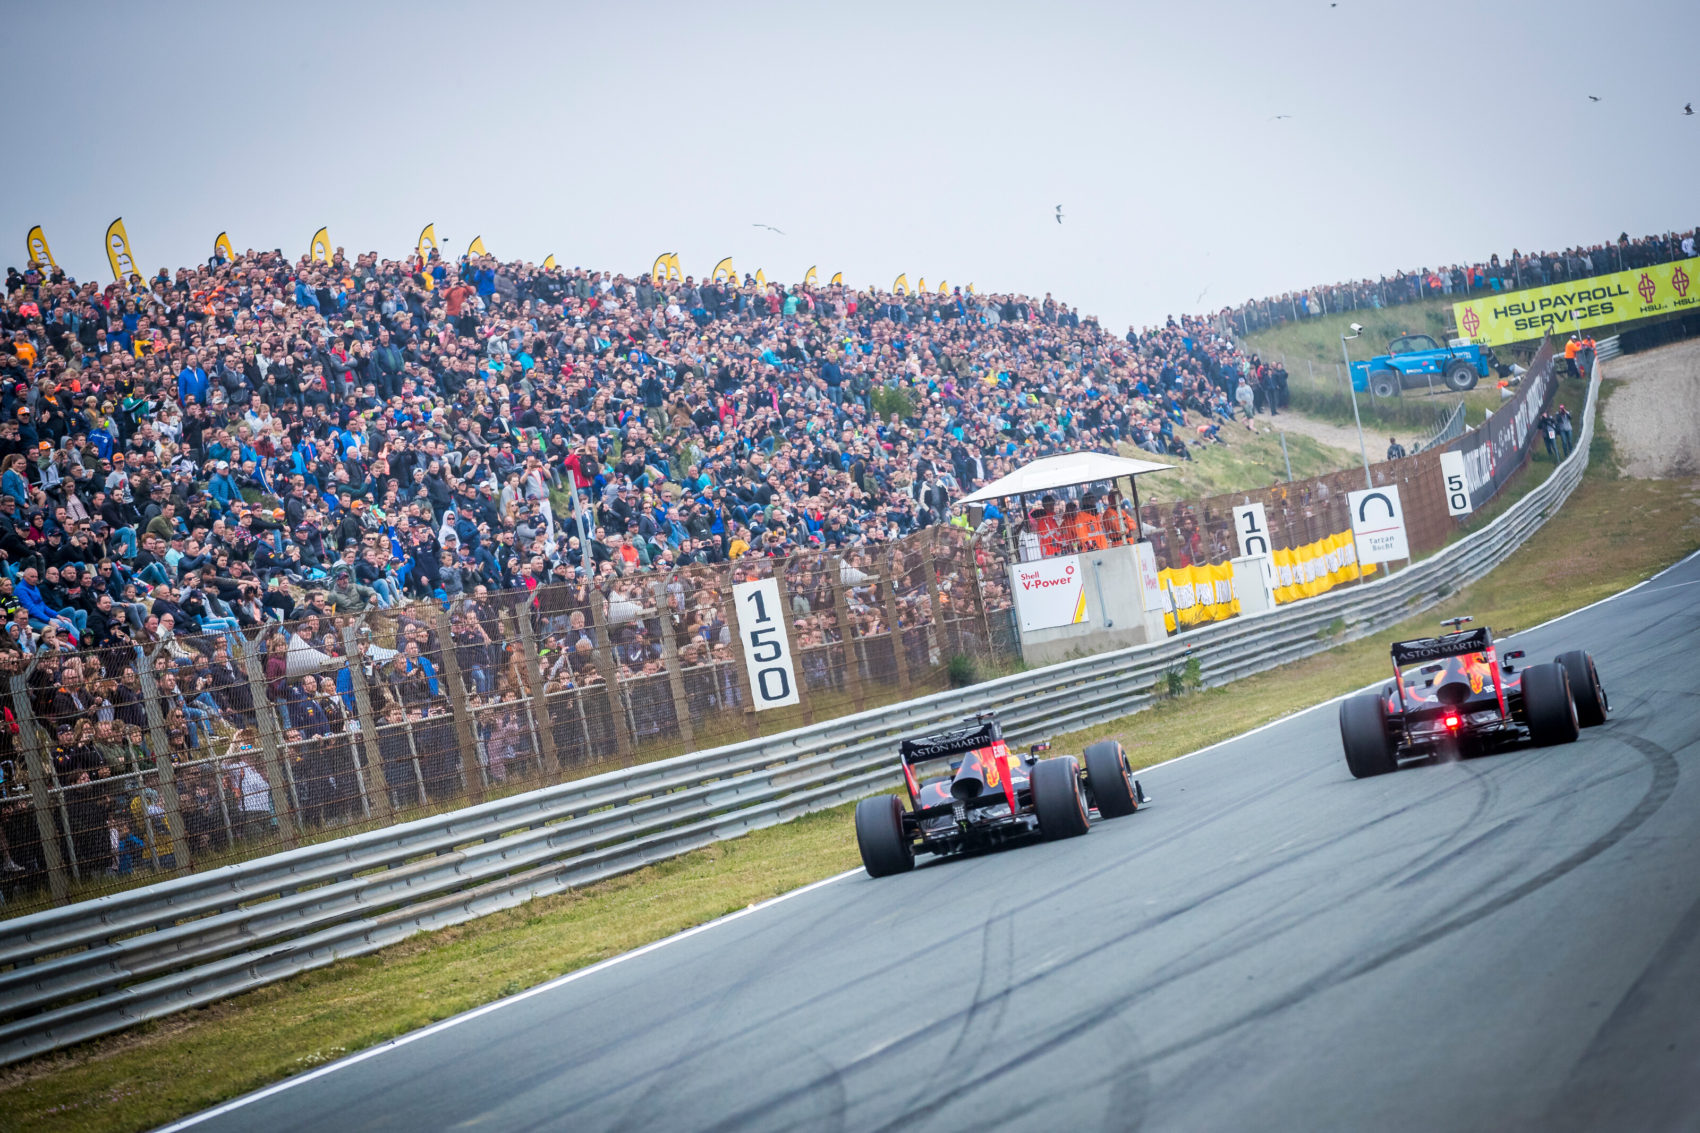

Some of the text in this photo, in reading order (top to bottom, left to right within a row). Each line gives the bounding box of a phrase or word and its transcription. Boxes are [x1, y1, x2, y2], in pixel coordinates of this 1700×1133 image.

[1493, 284, 1629, 319] HSU PAYROLL
[1514, 302, 1614, 331] SERVICES
[1448, 474, 1467, 510] 50
[1242, 511, 1272, 578] 10
[1020, 571, 1040, 581] Shell
[1022, 576, 1073, 591] V-Power
[747, 589, 791, 701] 150
[1400, 640, 1484, 660] ASTON MARTIN
[910, 734, 991, 758] ASTON MARTIN
